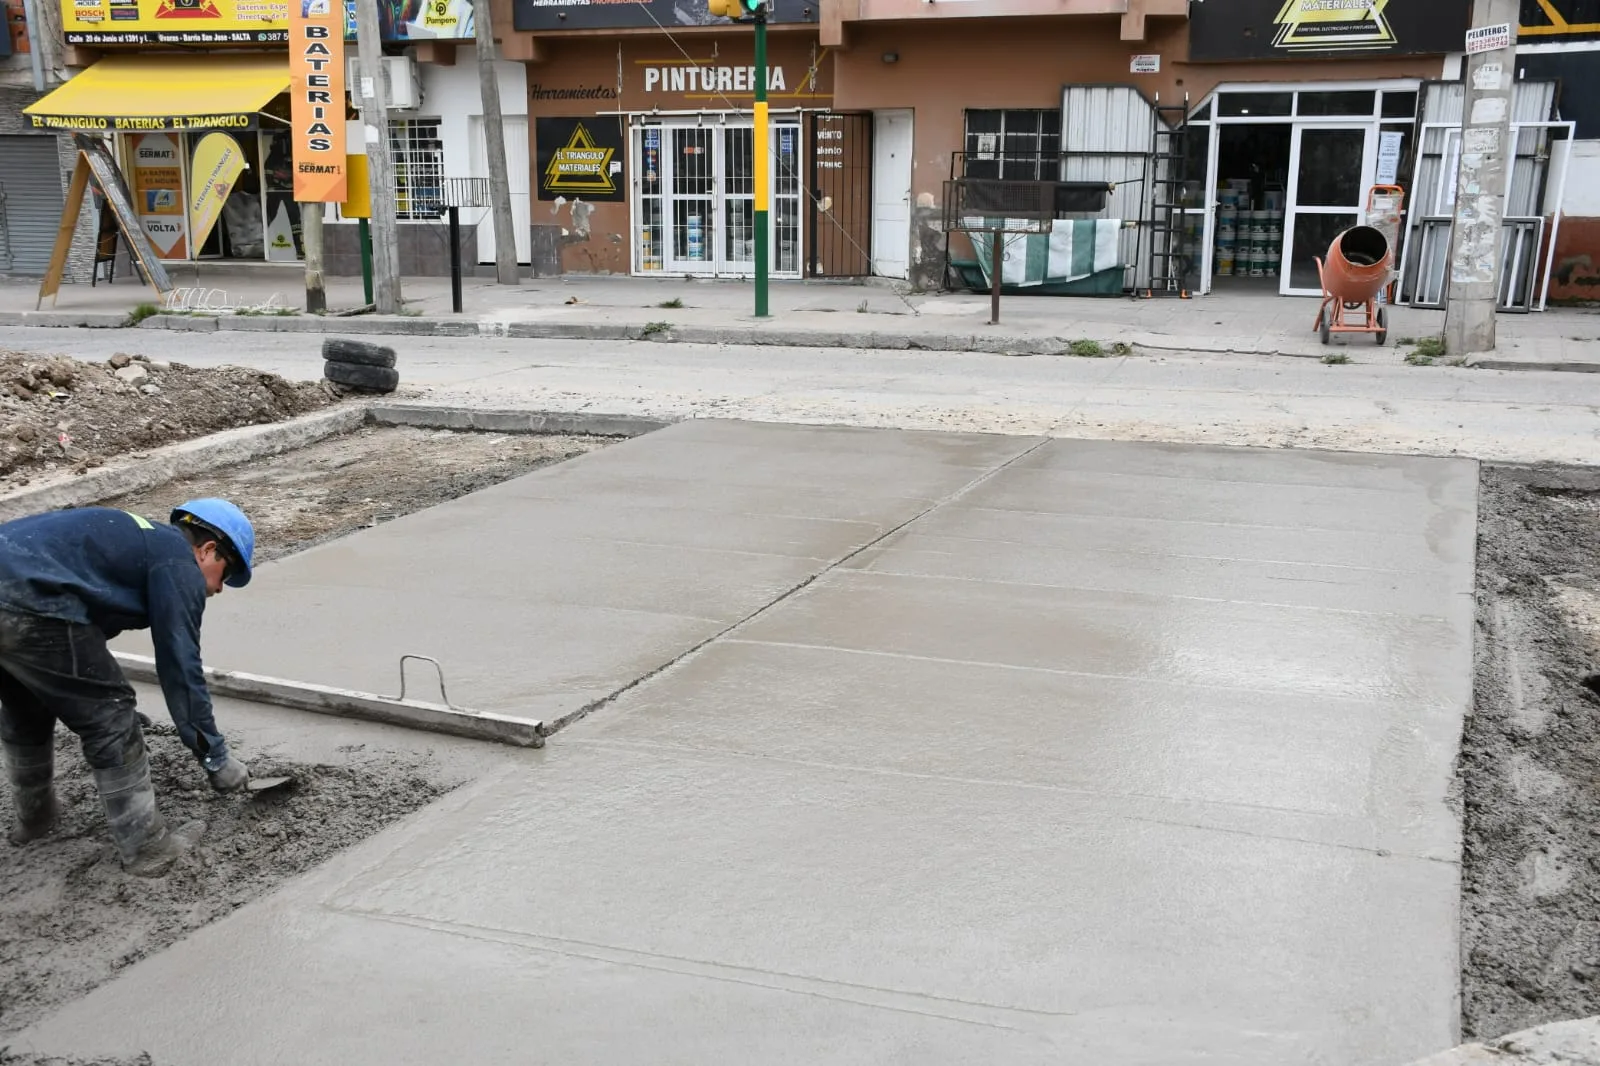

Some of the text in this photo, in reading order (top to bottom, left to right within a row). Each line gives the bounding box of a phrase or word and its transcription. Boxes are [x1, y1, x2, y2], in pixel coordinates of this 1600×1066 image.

[1301, 0, 1373, 10] MATERIALES
[426, 17, 457, 25] Pampero
[1467, 25, 1507, 39] PELOTEROS
[232, 33, 250, 41] SALTA
[306, 26, 332, 151] BATERIAS
[531, 83, 617, 100] Herramientas
[32, 115, 248, 129] EL TRIANGULO BATERIAS EL TRIANGULO
[557, 152, 605, 160] EL TRIANGULO
[299, 166, 335, 174] SERMAT
[559, 164, 600, 172] MATERIALES
